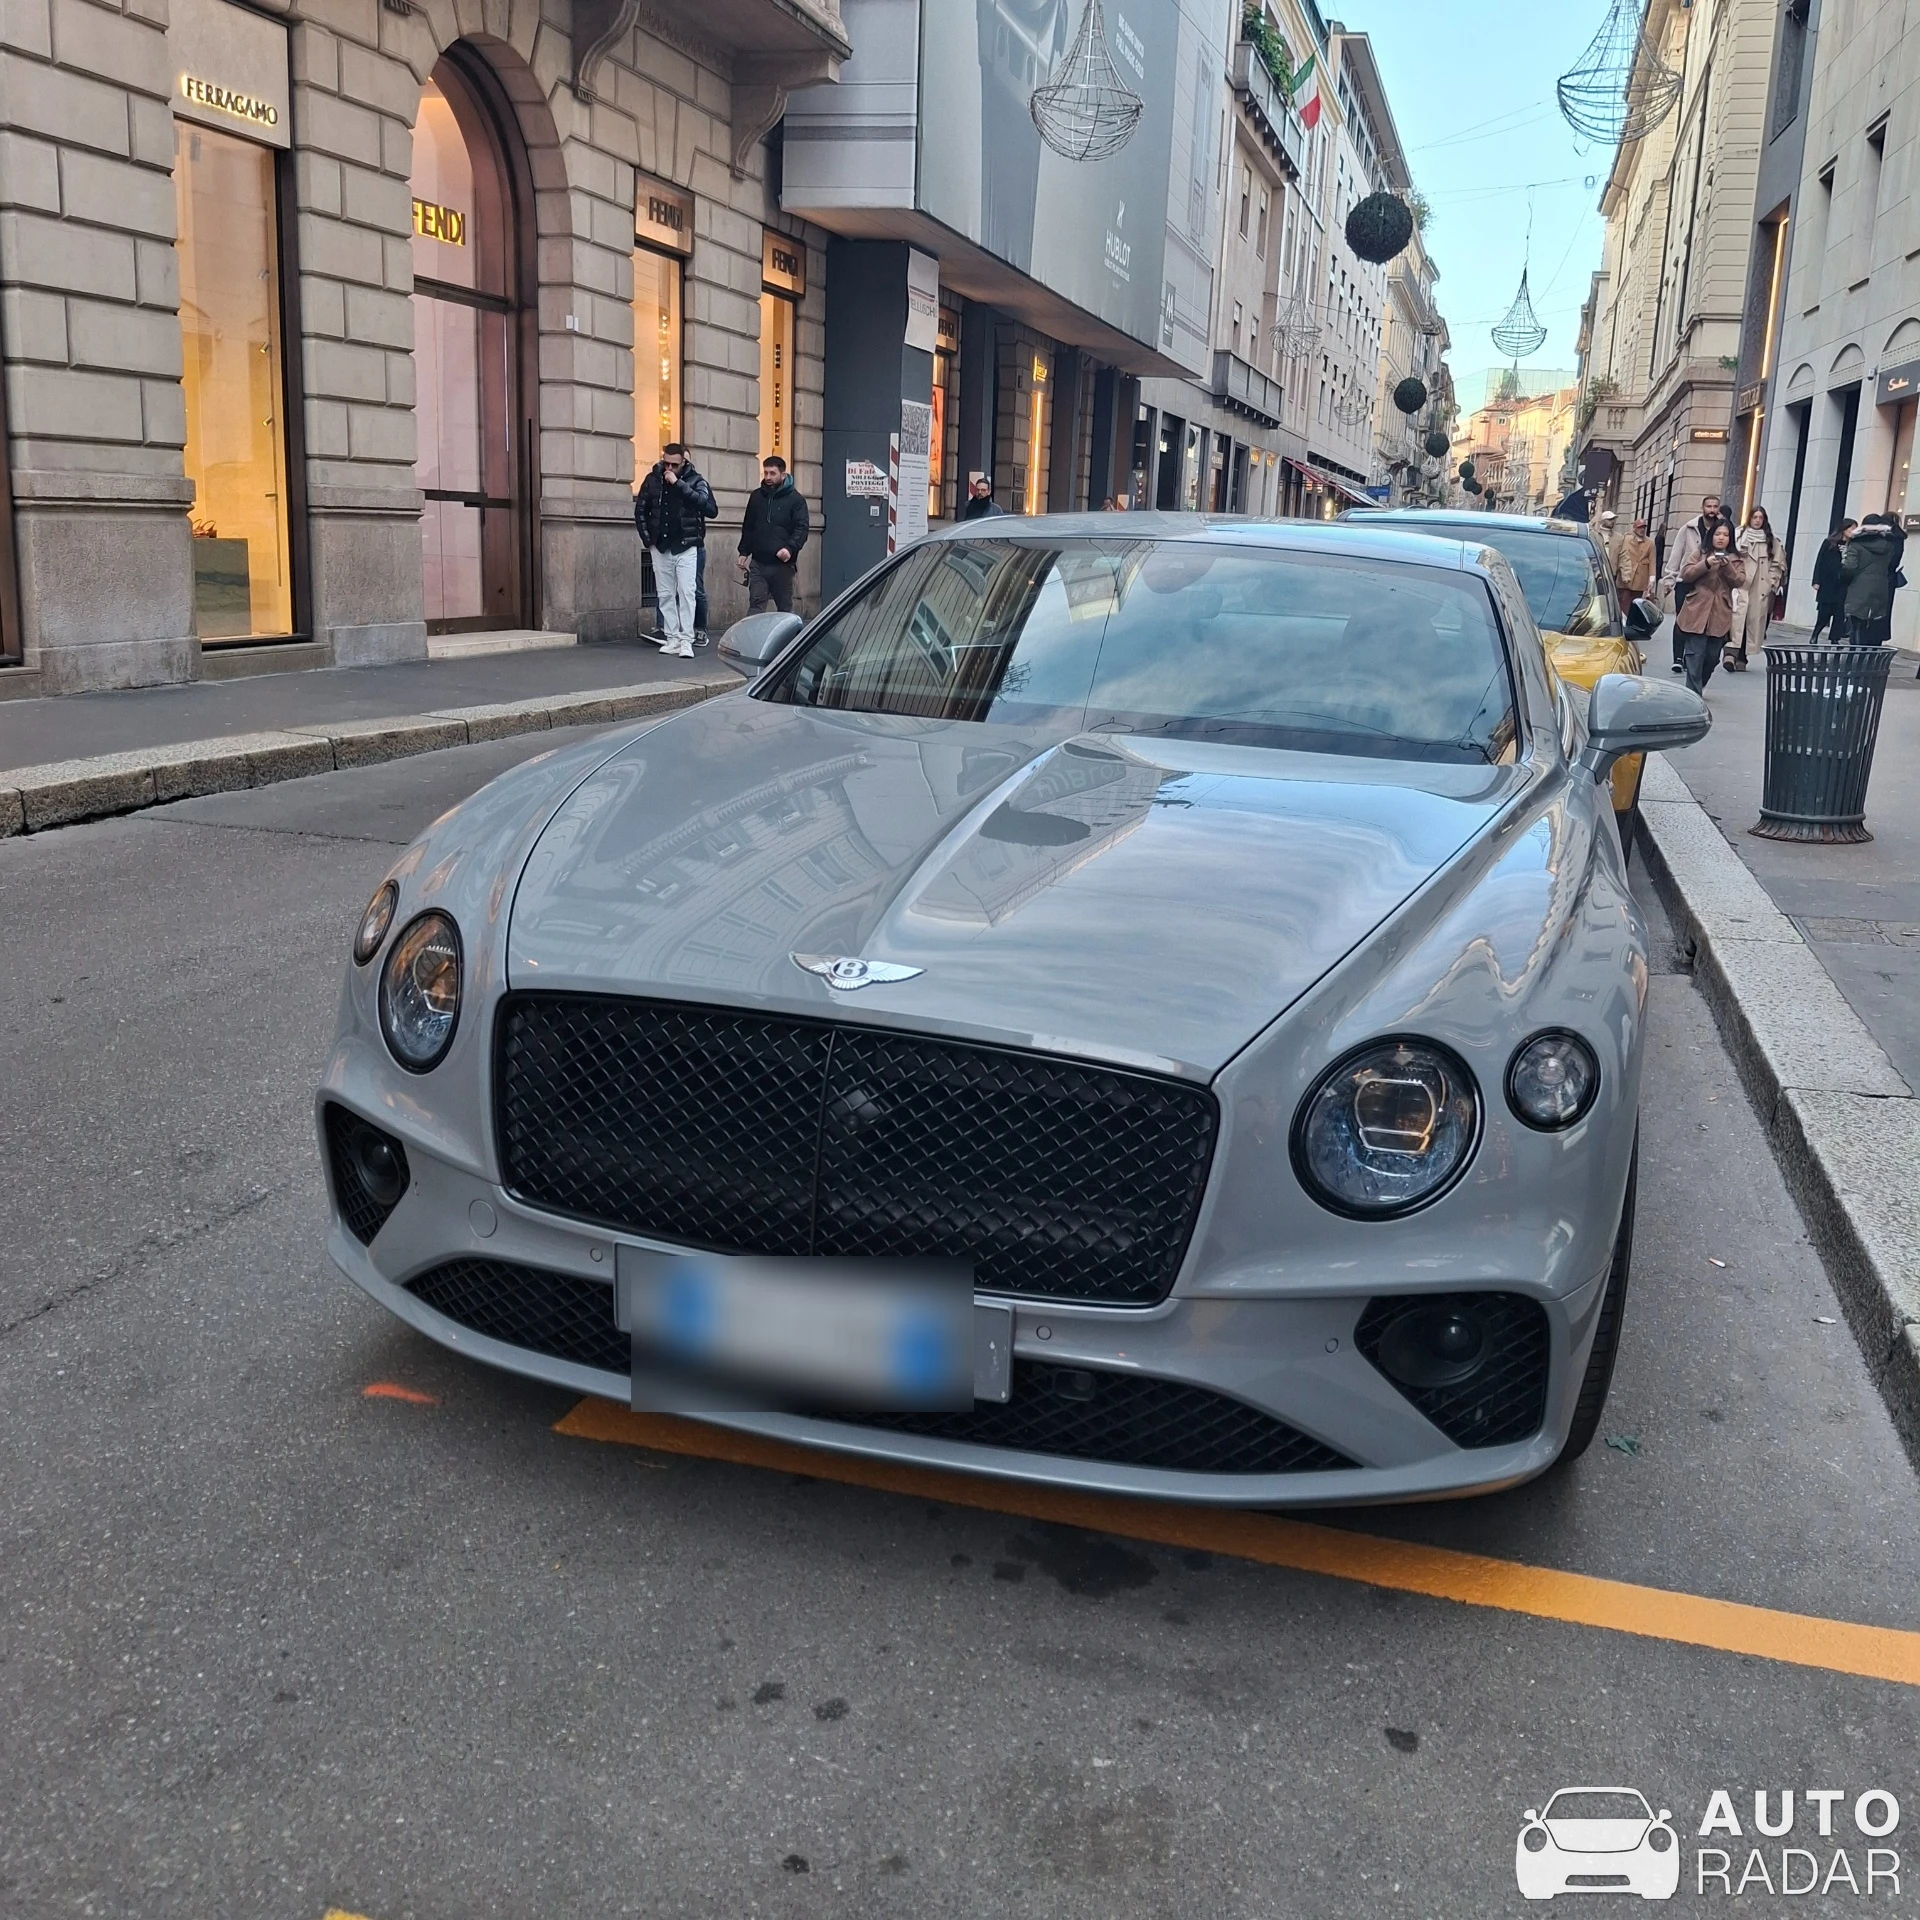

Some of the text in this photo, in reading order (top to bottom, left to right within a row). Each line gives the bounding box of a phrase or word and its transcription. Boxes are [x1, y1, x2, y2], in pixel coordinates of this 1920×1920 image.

[186, 77, 278, 125] FERRAGAMO
[411, 196, 466, 246] FENDI
[649, 196, 683, 233] FENDI
[771, 247, 799, 278] FENDI
[1105, 228, 1131, 269] HUBLOT
